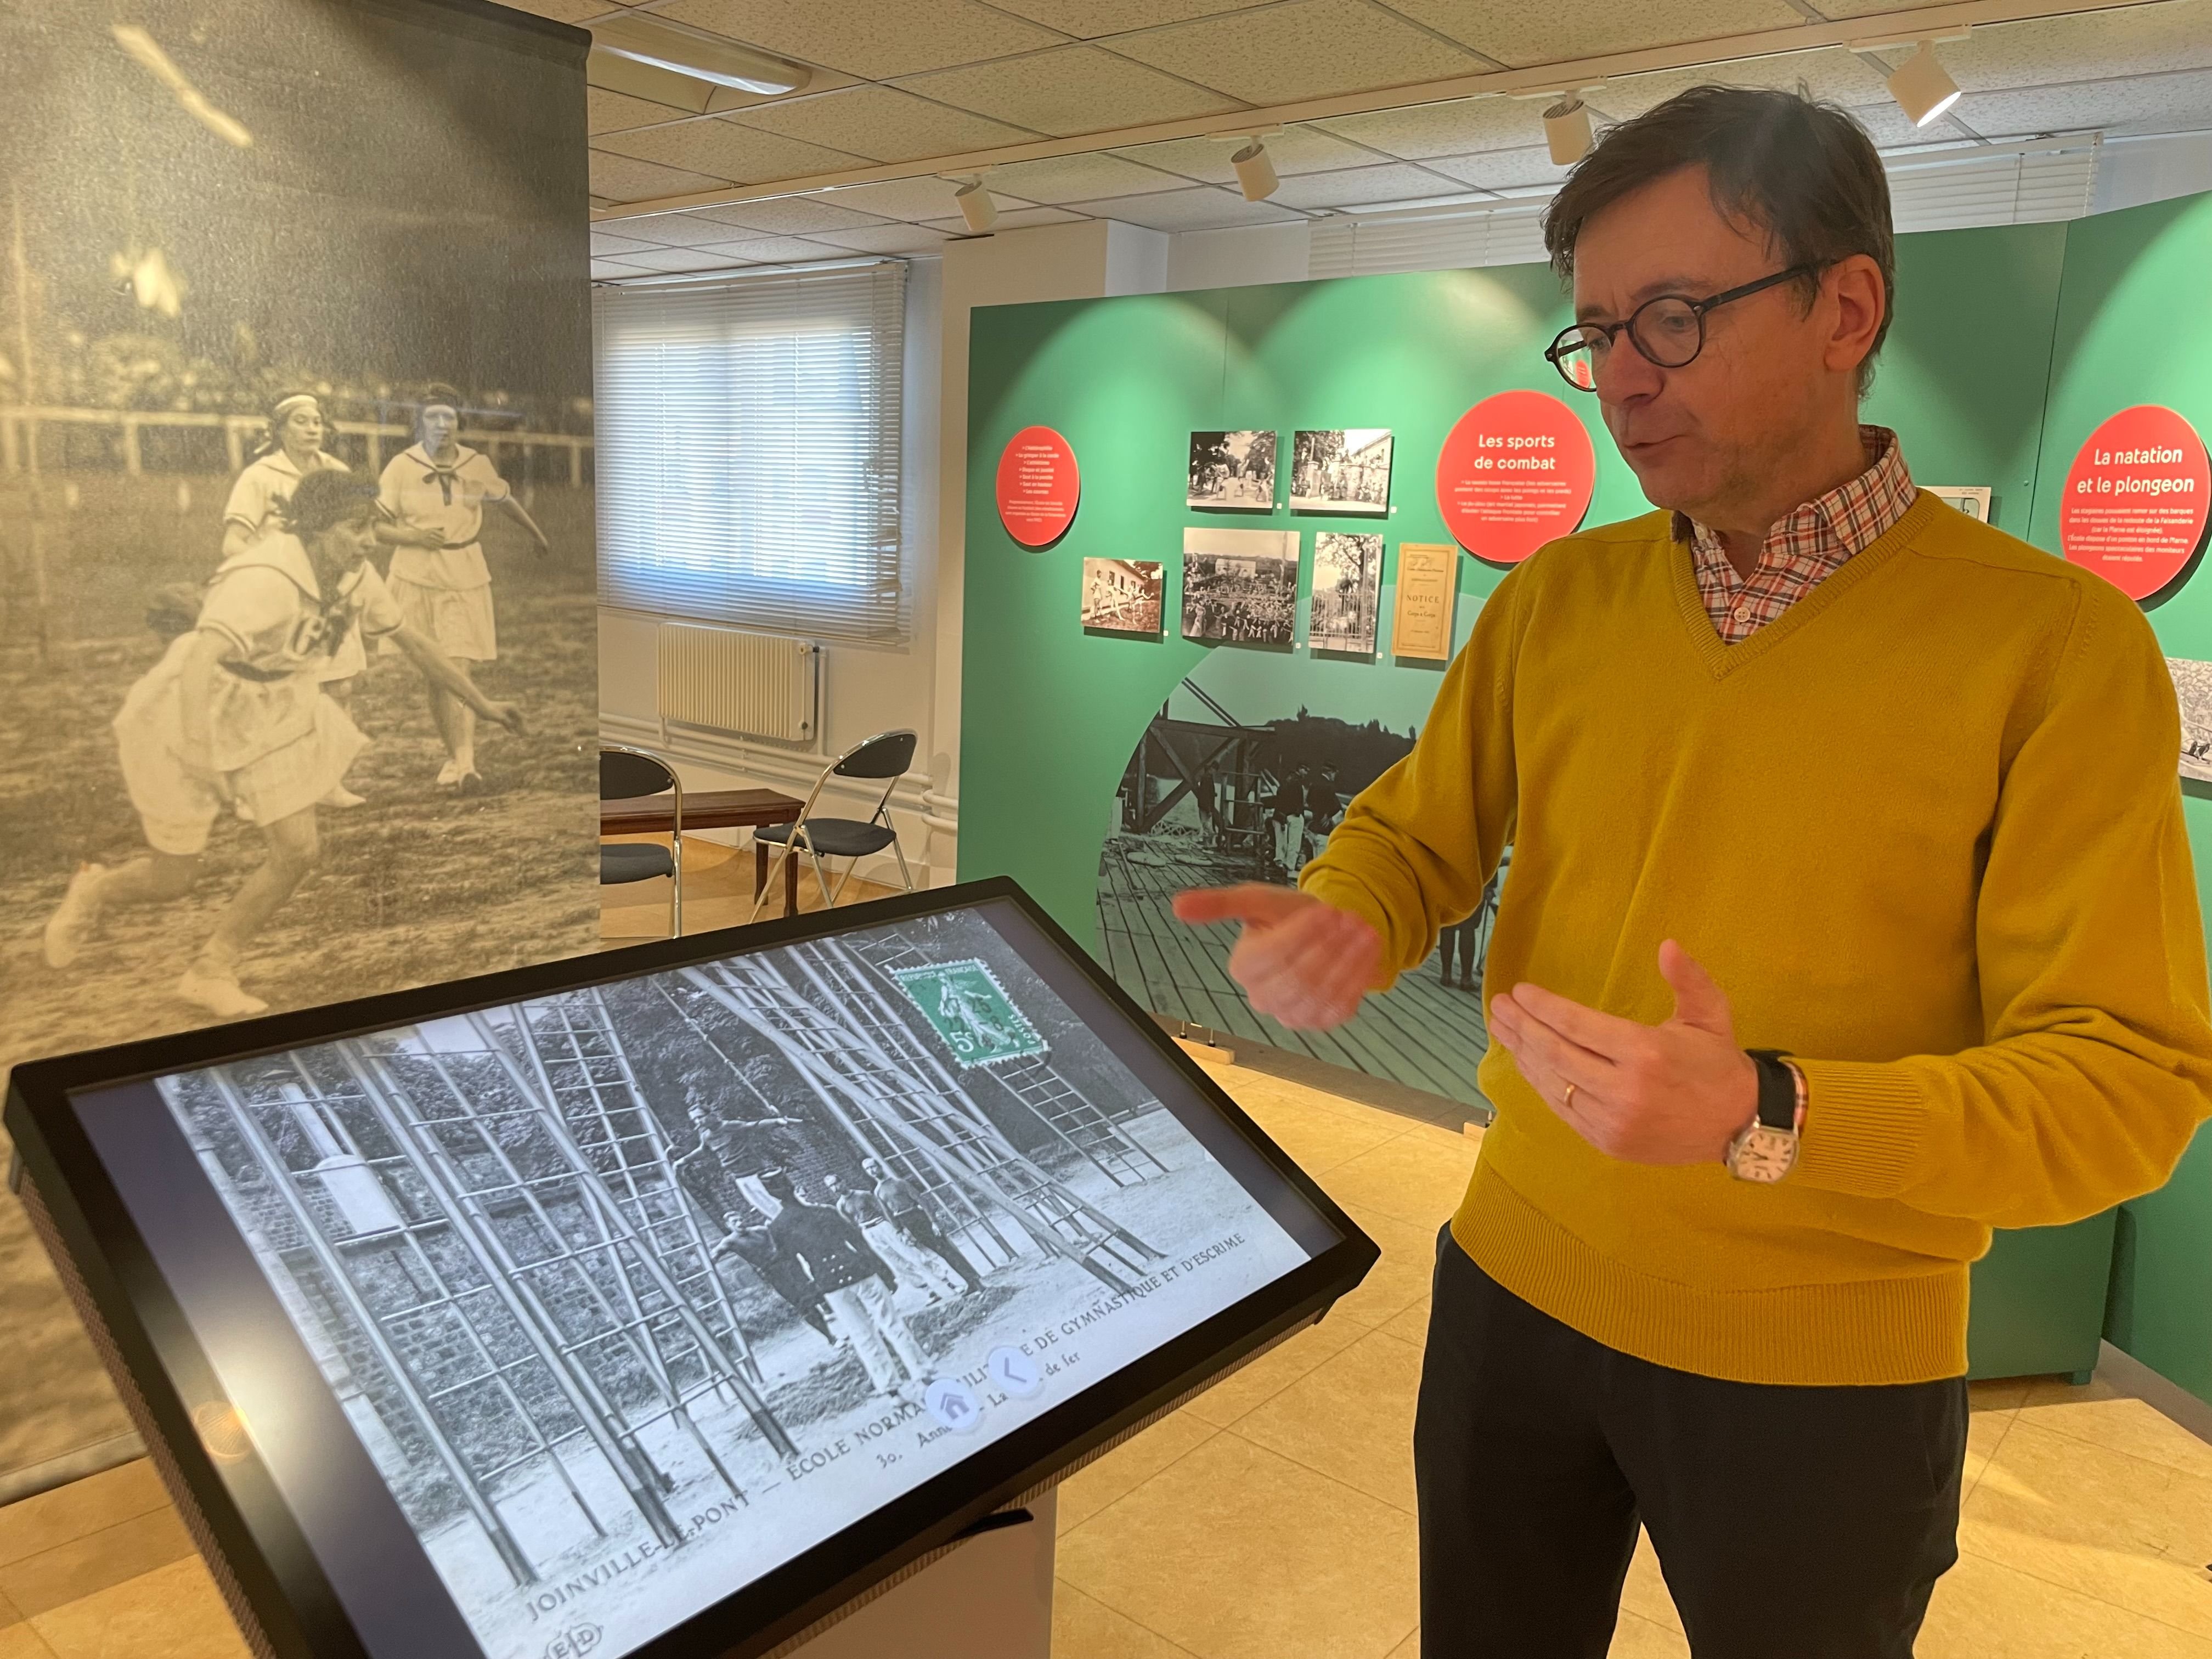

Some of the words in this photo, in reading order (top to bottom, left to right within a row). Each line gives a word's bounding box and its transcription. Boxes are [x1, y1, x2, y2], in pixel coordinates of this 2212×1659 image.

[1479, 434, 1503, 448] Les
[1507, 435, 1555, 450] sports
[1474, 456, 1493, 470] de
[1497, 456, 1556, 470] combat
[2094, 448, 2110, 465] La
[2114, 445, 2182, 465] natation
[2077, 478, 2093, 493] et
[2097, 476, 2112, 493] le
[2115, 476, 2194, 496] plongeon
[1406, 594, 1440, 604] NOTICE
[854, 1397, 928, 1447] NORMA
[1034, 1330, 1059, 1350] DE
[1060, 1276, 1162, 1335] GYMNASTIQUE
[1160, 1266, 1180, 1283] ET
[1181, 1232, 1245, 1273] D'ESCRIME
[987, 1392, 1008, 1408] La
[1045, 1361, 1061, 1377] de
[1061, 1351, 1081, 1368] fer
